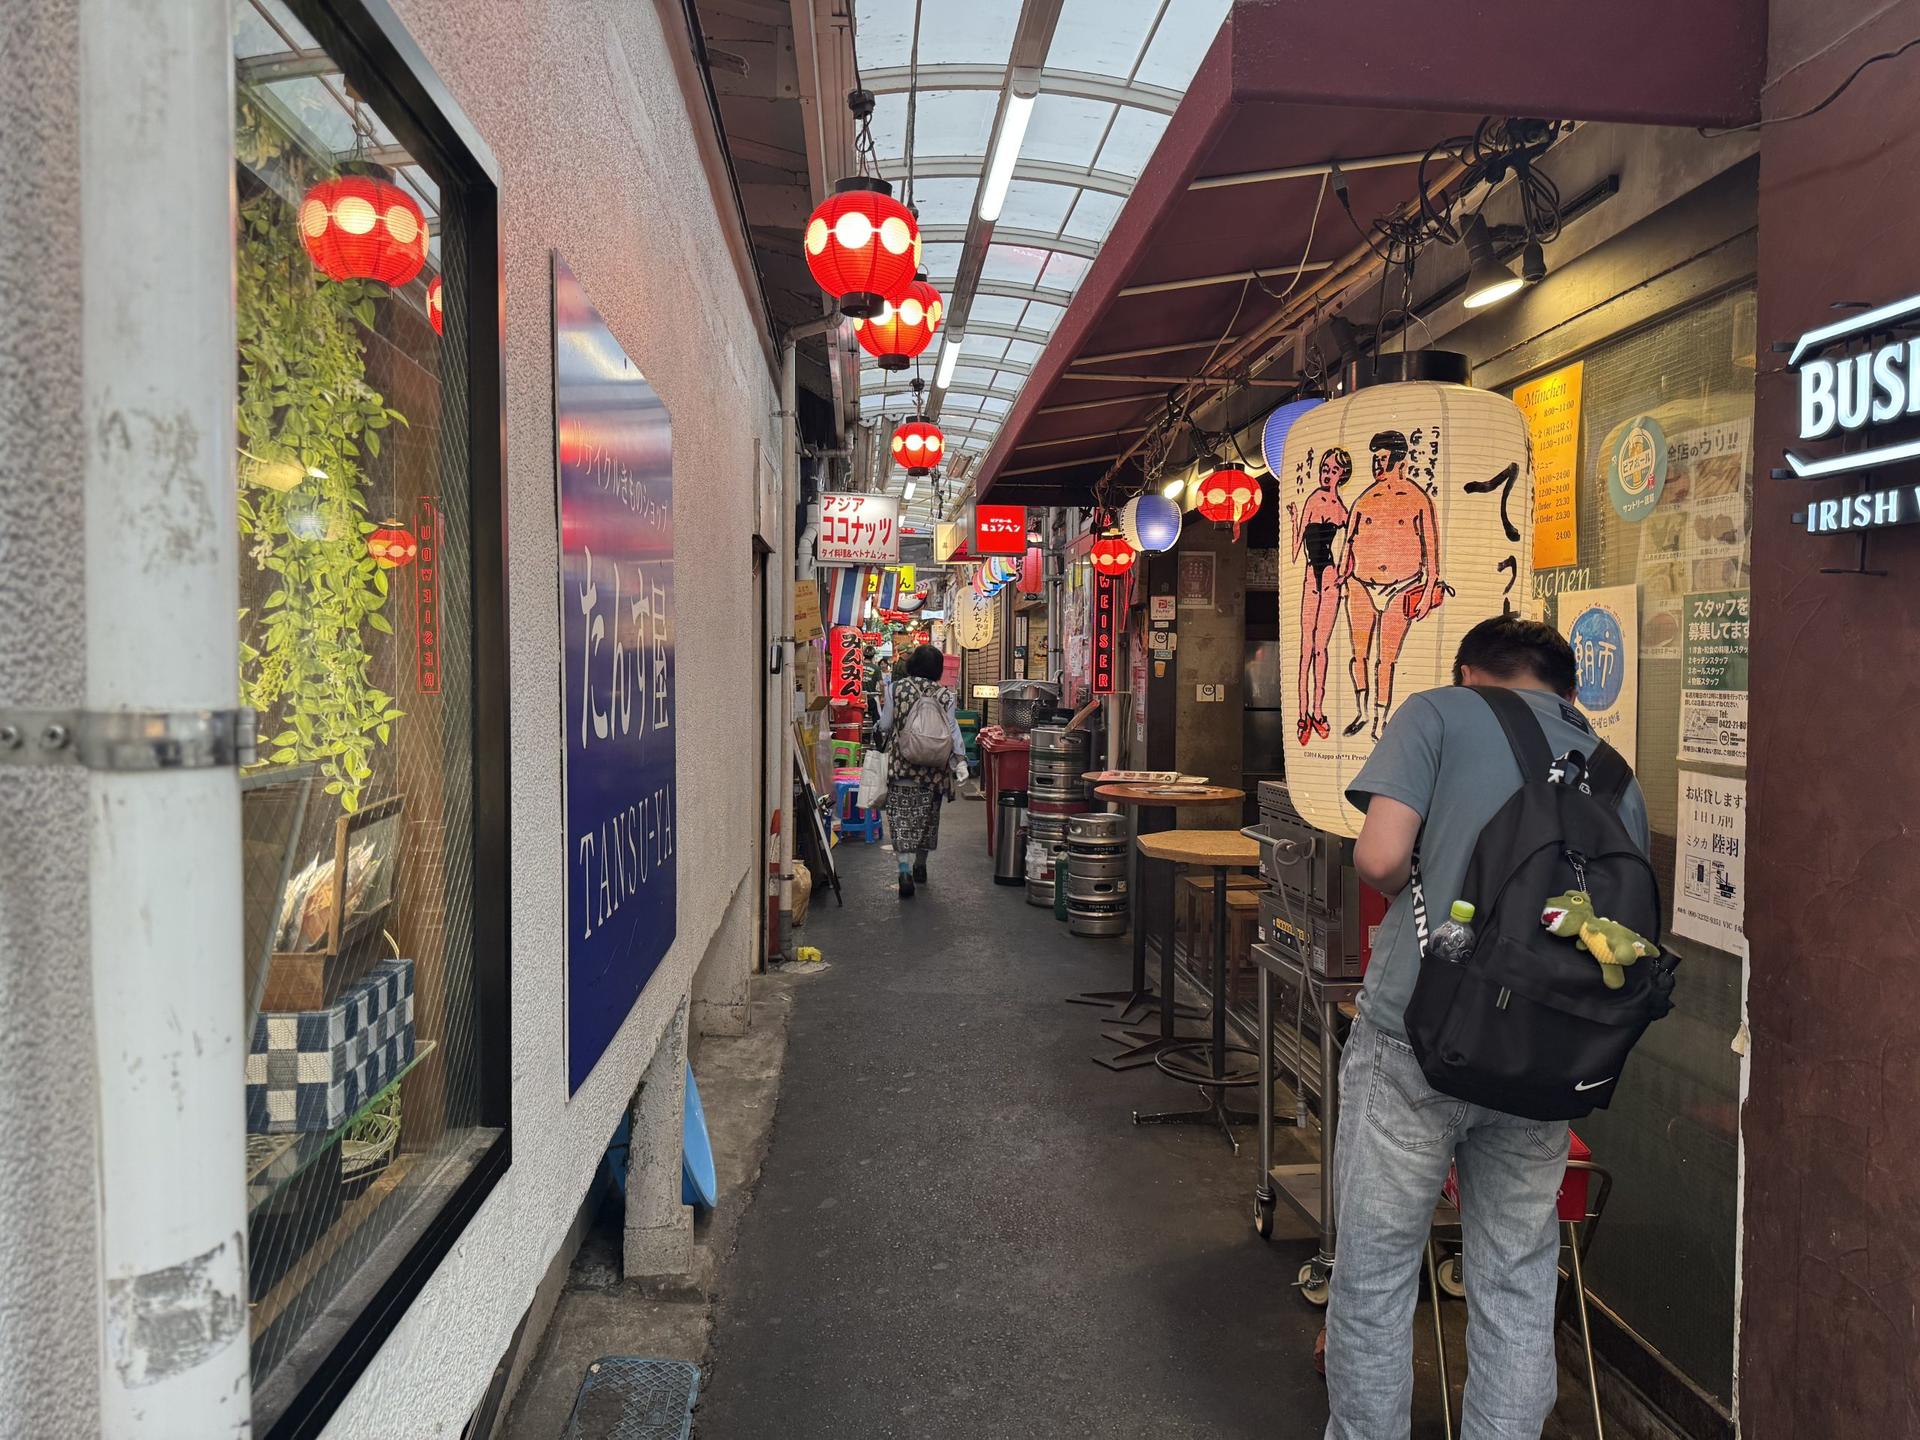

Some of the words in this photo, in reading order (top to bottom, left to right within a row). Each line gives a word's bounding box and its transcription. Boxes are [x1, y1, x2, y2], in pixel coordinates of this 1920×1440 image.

[823, 496, 865, 512] アジア
[1807, 490, 1899, 532] IRISH
[822, 515, 893, 546] ココナッツ
[1532, 566, 1592, 599] nchen
[971, 591, 984, 642] あんちゃん
[1693, 597, 1748, 618] スタッフを
[1688, 621, 1749, 641] 募集してます
[578, 545, 670, 750] たんす屋
[1574, 630, 1617, 689] 朝市
[840, 633, 862, 697] みんみん
[1719, 711, 1729, 719] Tel:
[1686, 785, 1743, 809] お店貸します
[1686, 834, 1708, 850] ミタカ
[579, 783, 673, 941] TANSU-YA
